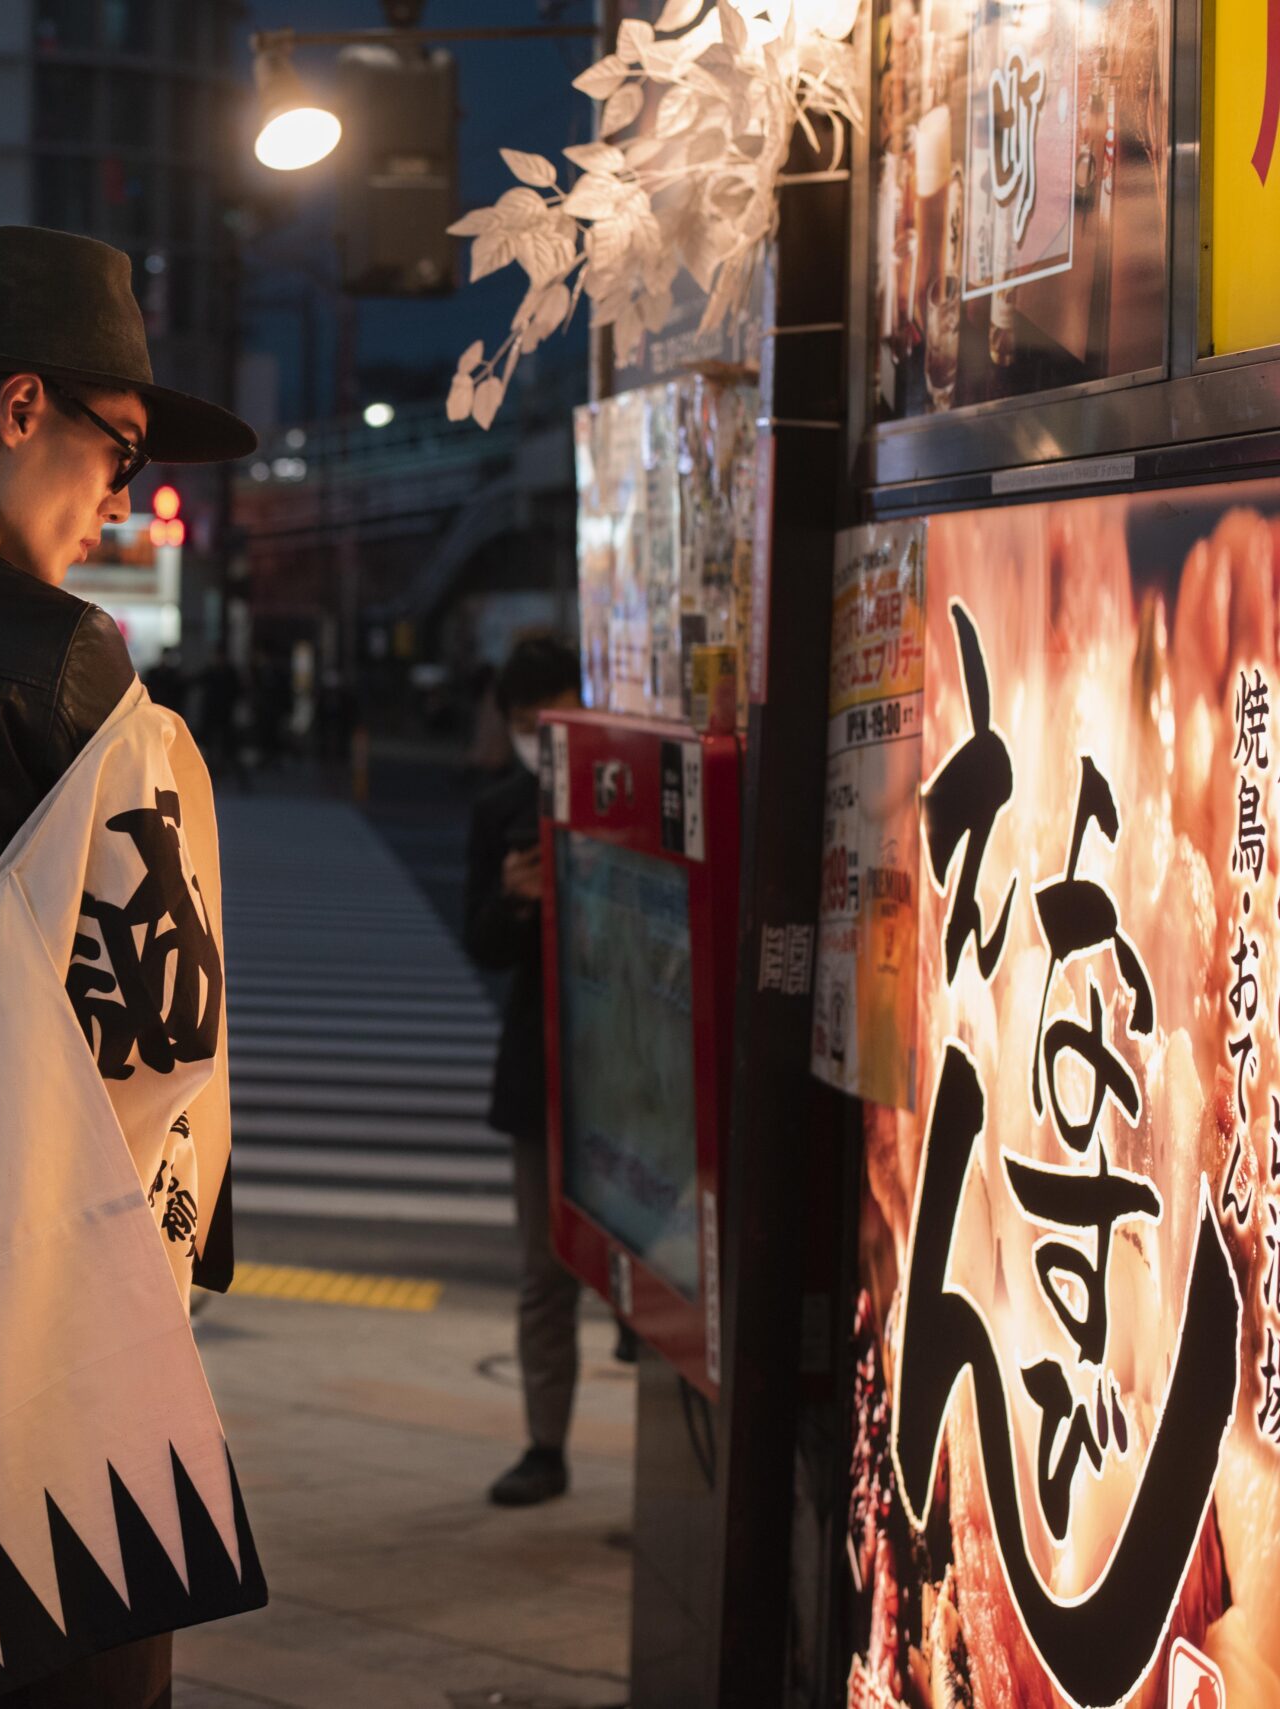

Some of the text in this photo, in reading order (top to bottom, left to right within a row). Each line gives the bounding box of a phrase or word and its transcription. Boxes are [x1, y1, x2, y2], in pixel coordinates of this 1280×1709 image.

[1003, 756, 1156, 1540] なすび
[1222, 669, 1270, 1225] 焼鳥・おでん
